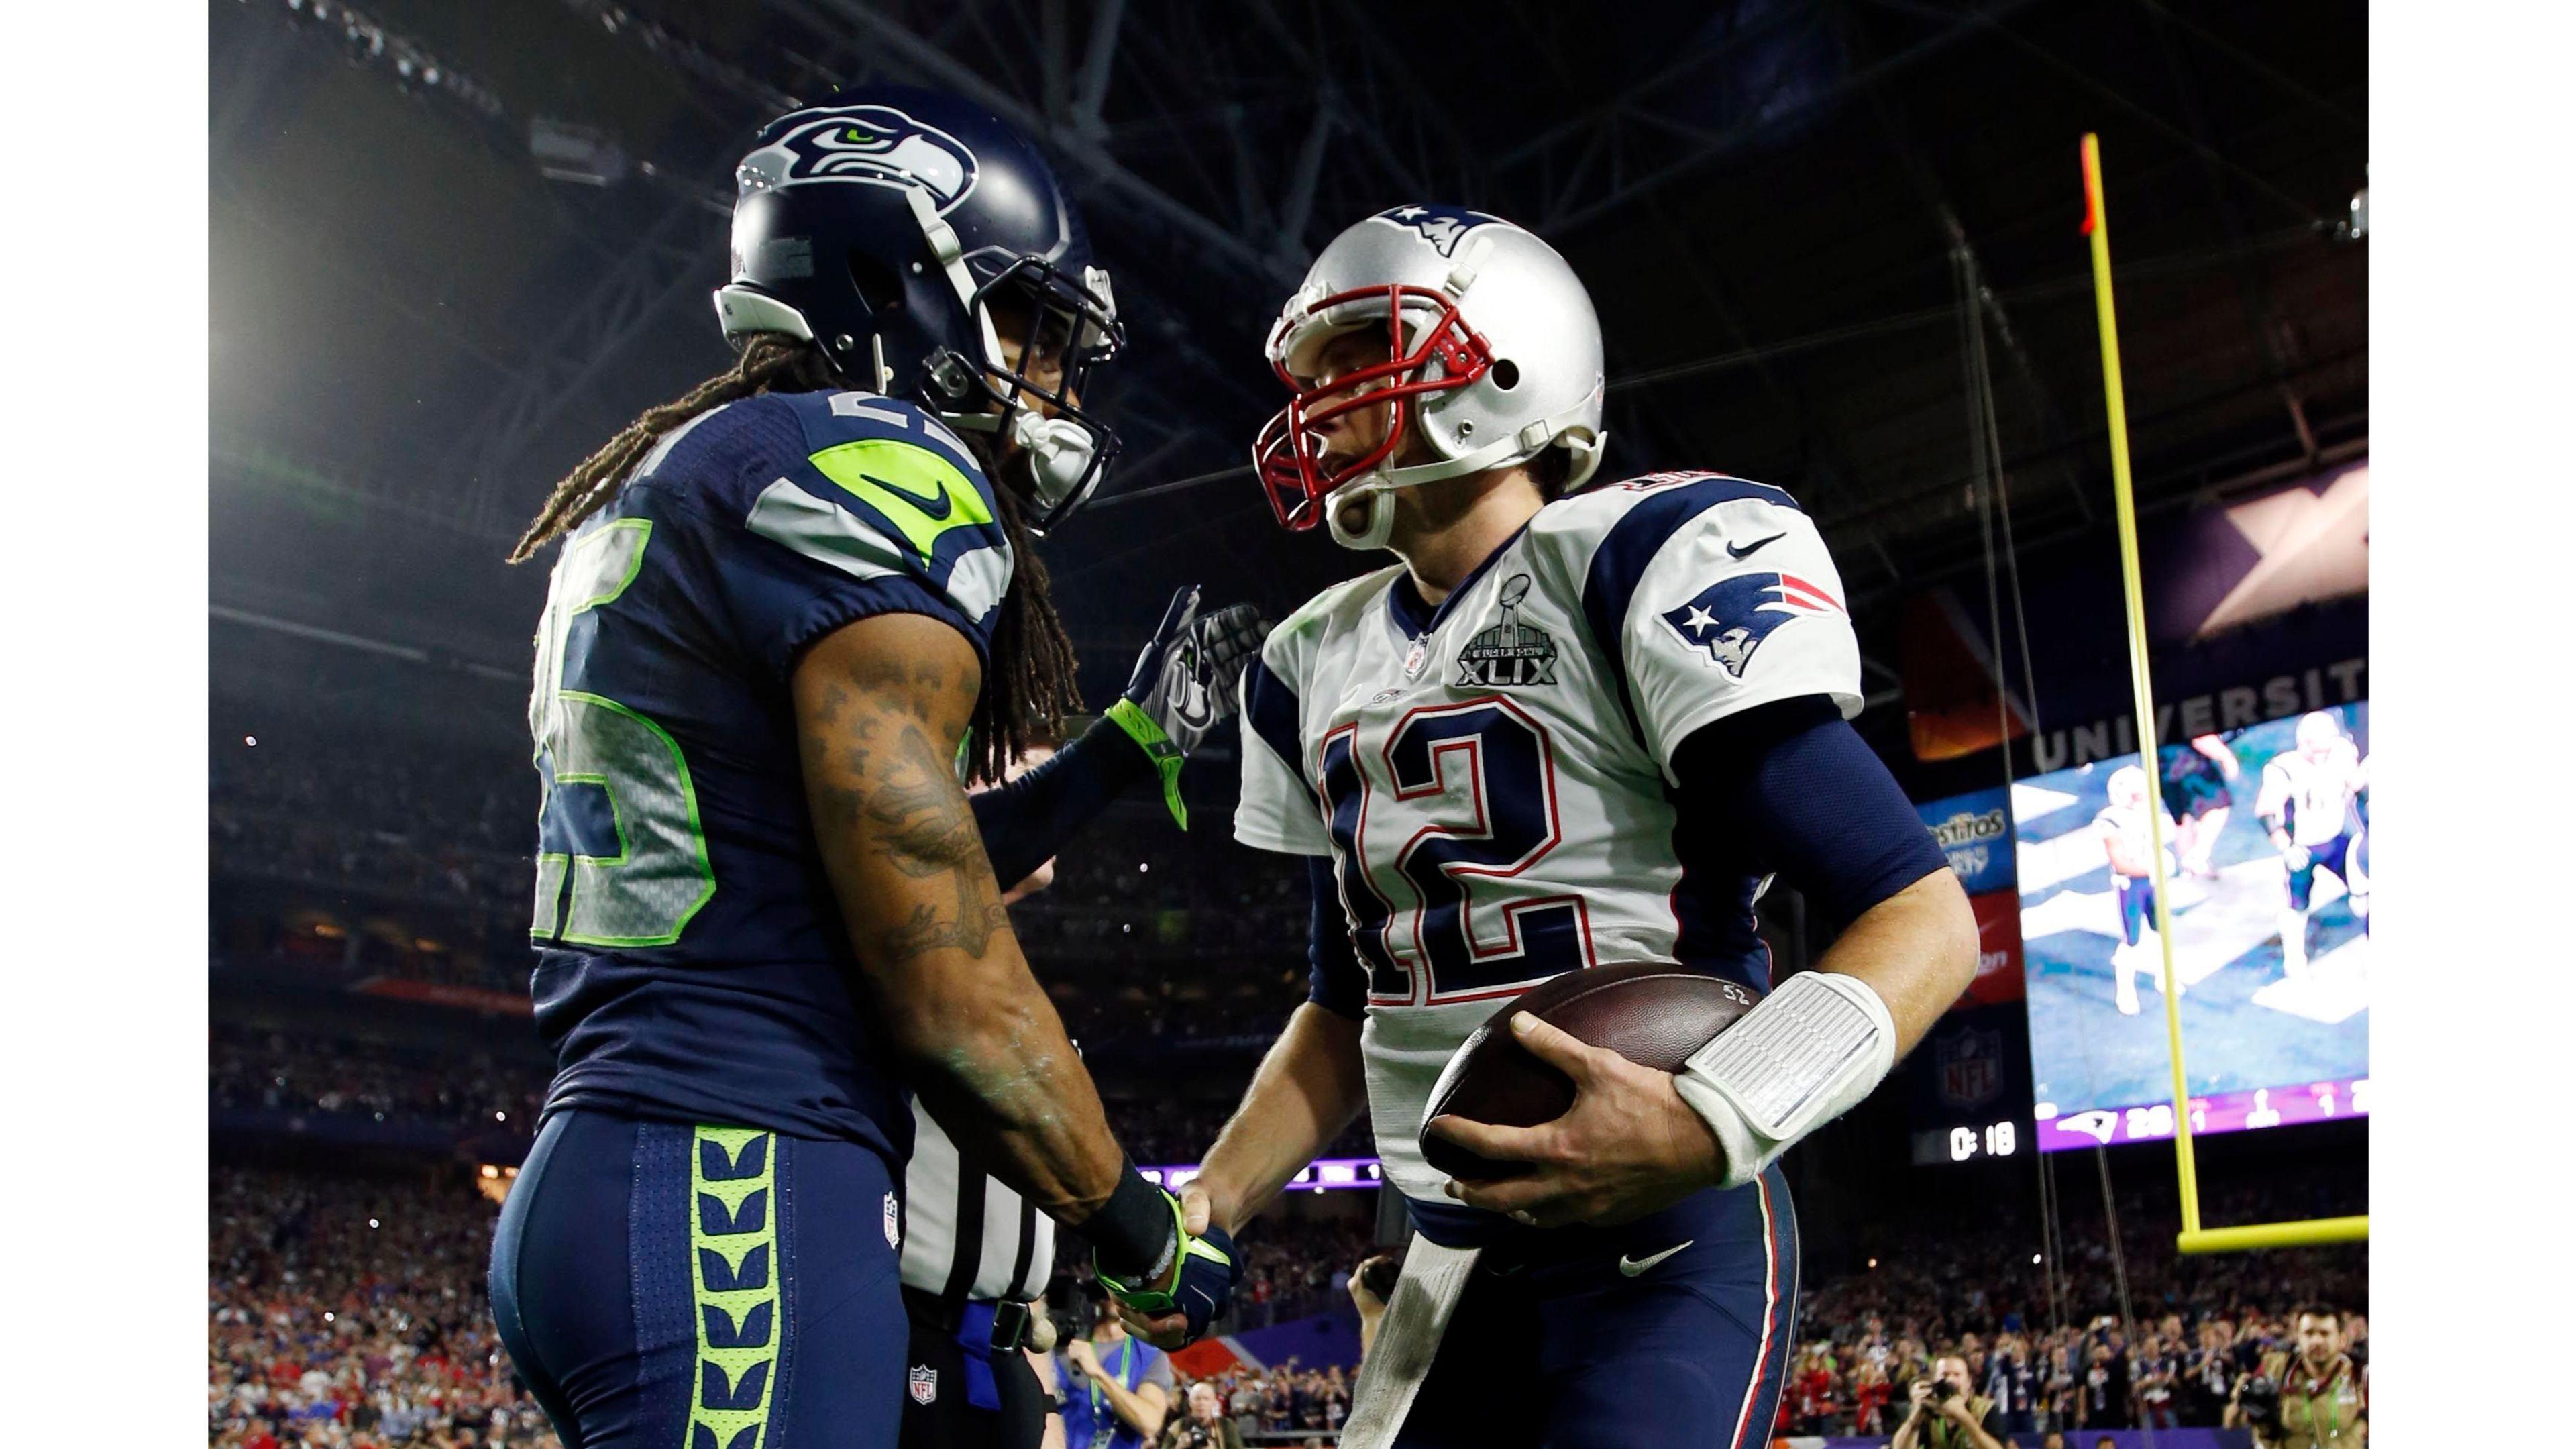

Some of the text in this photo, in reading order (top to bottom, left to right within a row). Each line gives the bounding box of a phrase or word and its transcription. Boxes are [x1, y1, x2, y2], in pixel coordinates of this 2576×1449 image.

[1456, 656, 1558, 686] XLIX
[1318, 695, 1597, 1006] 12
[1950, 1120, 2016, 1161] 0:18
[913, 1382, 932, 1399] NFL
